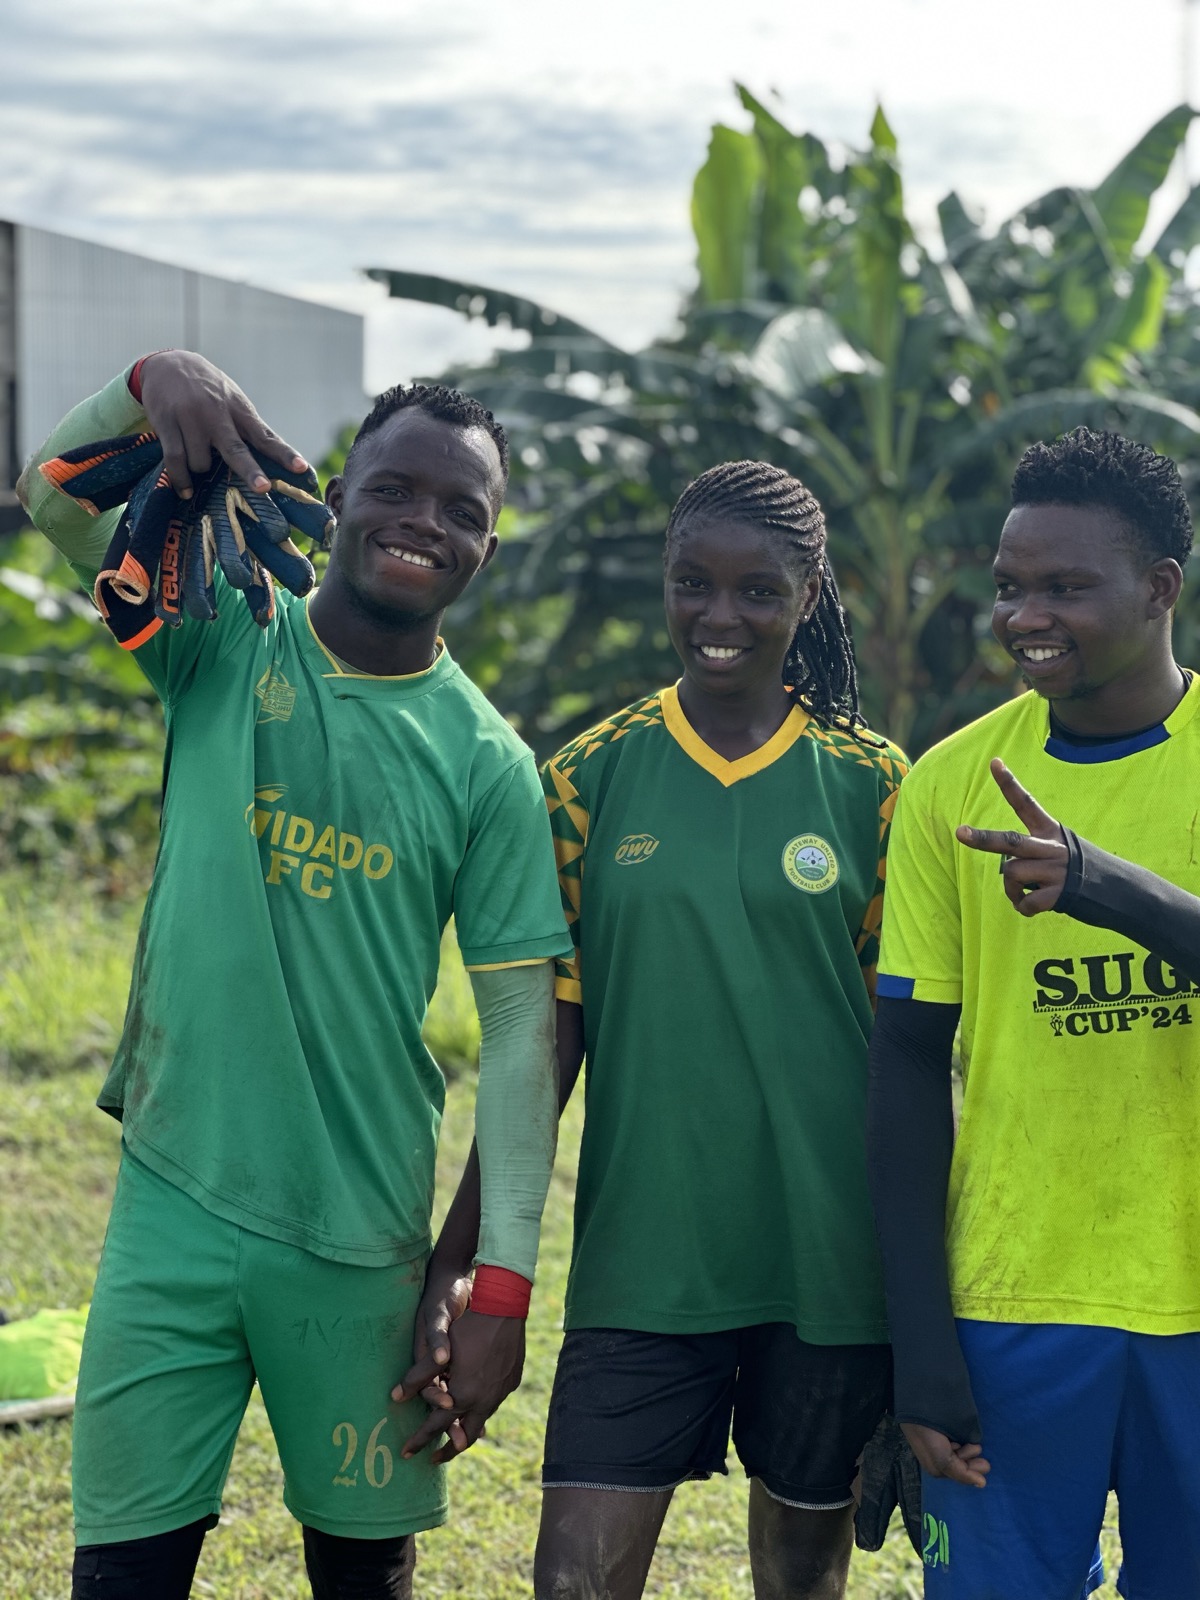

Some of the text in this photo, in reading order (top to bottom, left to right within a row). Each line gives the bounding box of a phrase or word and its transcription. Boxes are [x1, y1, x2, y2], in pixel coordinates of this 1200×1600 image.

[788, 838, 836, 869] GATEWAY UNITED
[266, 849, 335, 900] FC
[788, 867, 815, 890] FOOTBALL
[815, 878, 831, 889] CLUB
[332, 1417, 394, 1489] 26
